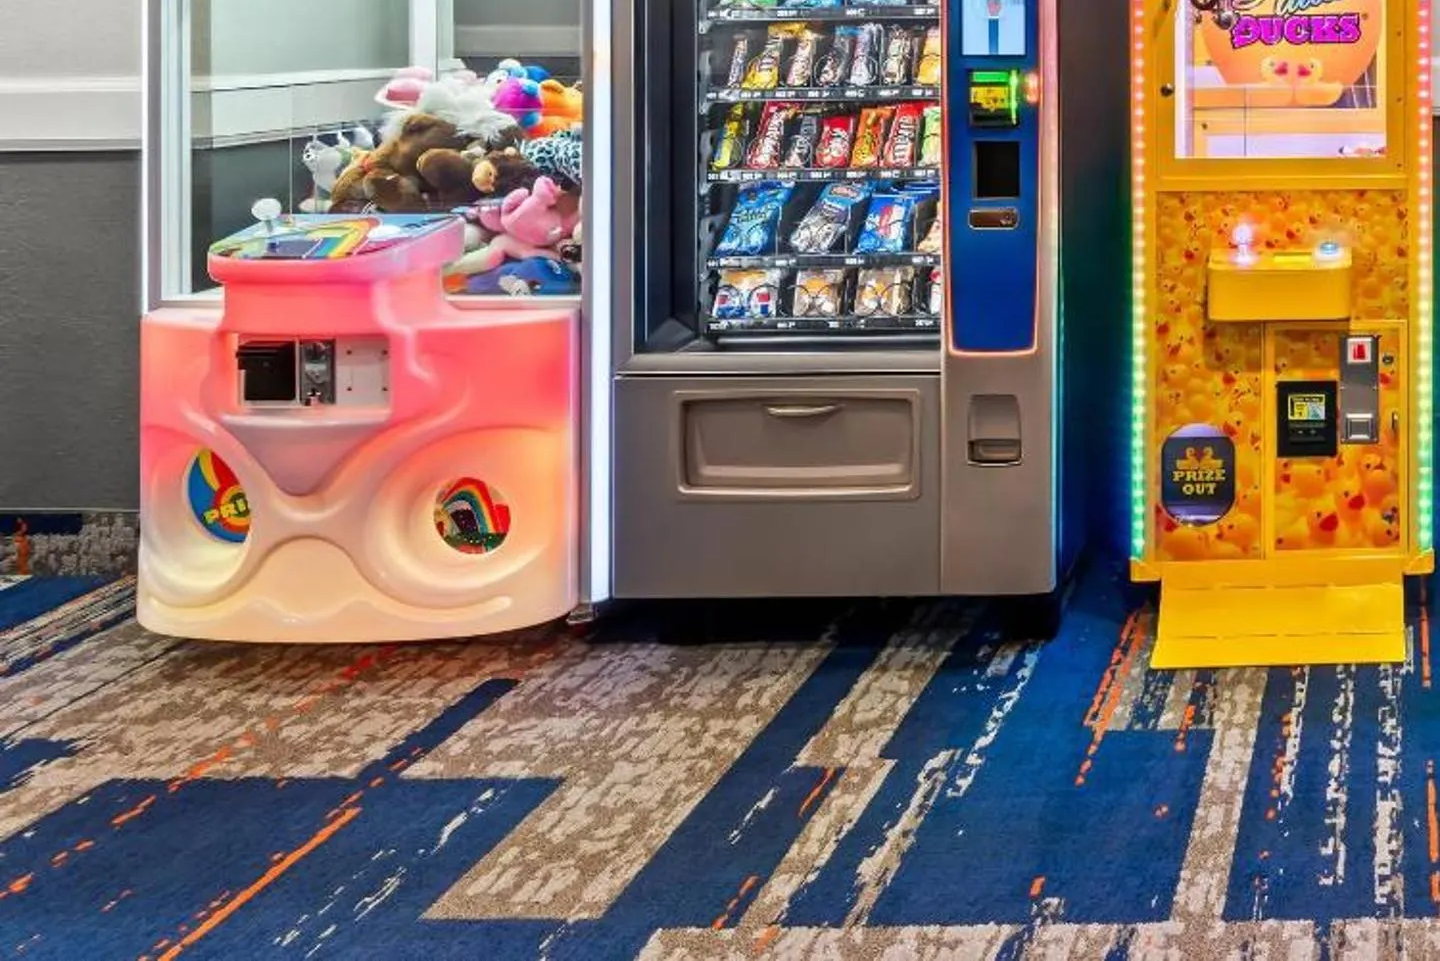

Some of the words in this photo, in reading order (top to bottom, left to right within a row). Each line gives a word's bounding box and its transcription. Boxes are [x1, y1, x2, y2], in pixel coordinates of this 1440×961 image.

[1231, 12, 1361, 50] DUCKS
[1172, 469, 1226, 482] PRIZE
[1182, 483, 1217, 496] OUT
